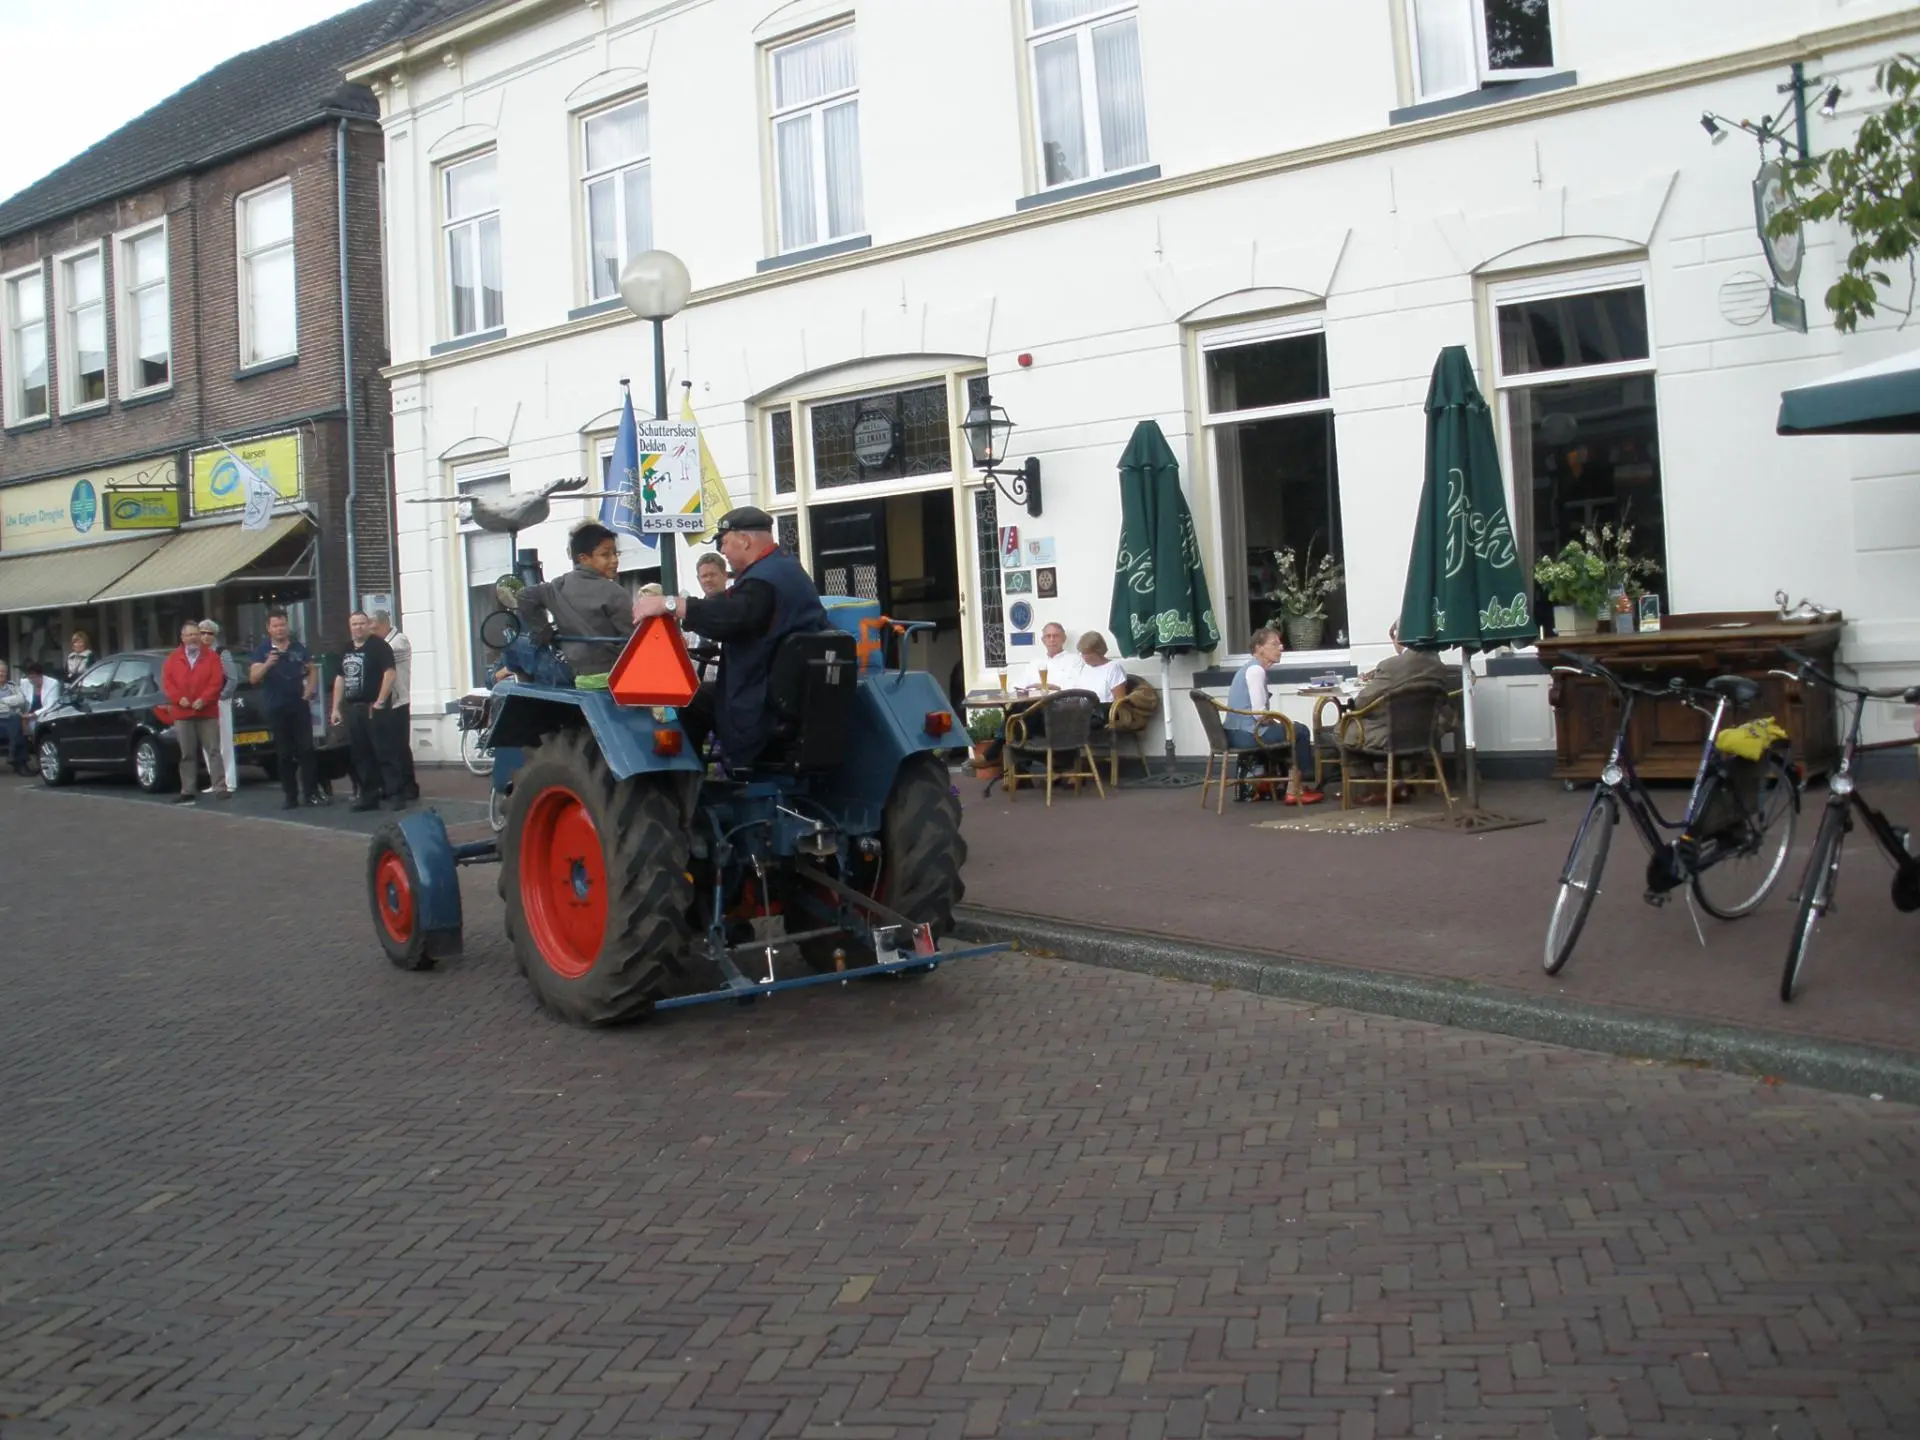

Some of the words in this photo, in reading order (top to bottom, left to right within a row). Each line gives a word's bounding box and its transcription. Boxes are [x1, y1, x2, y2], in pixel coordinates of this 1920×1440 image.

[638, 423, 697, 438] Schuttersfeest
[640, 439, 667, 453] Delden
[643, 519, 673, 529] 4-5-6
[676, 518, 704, 531] Sept
